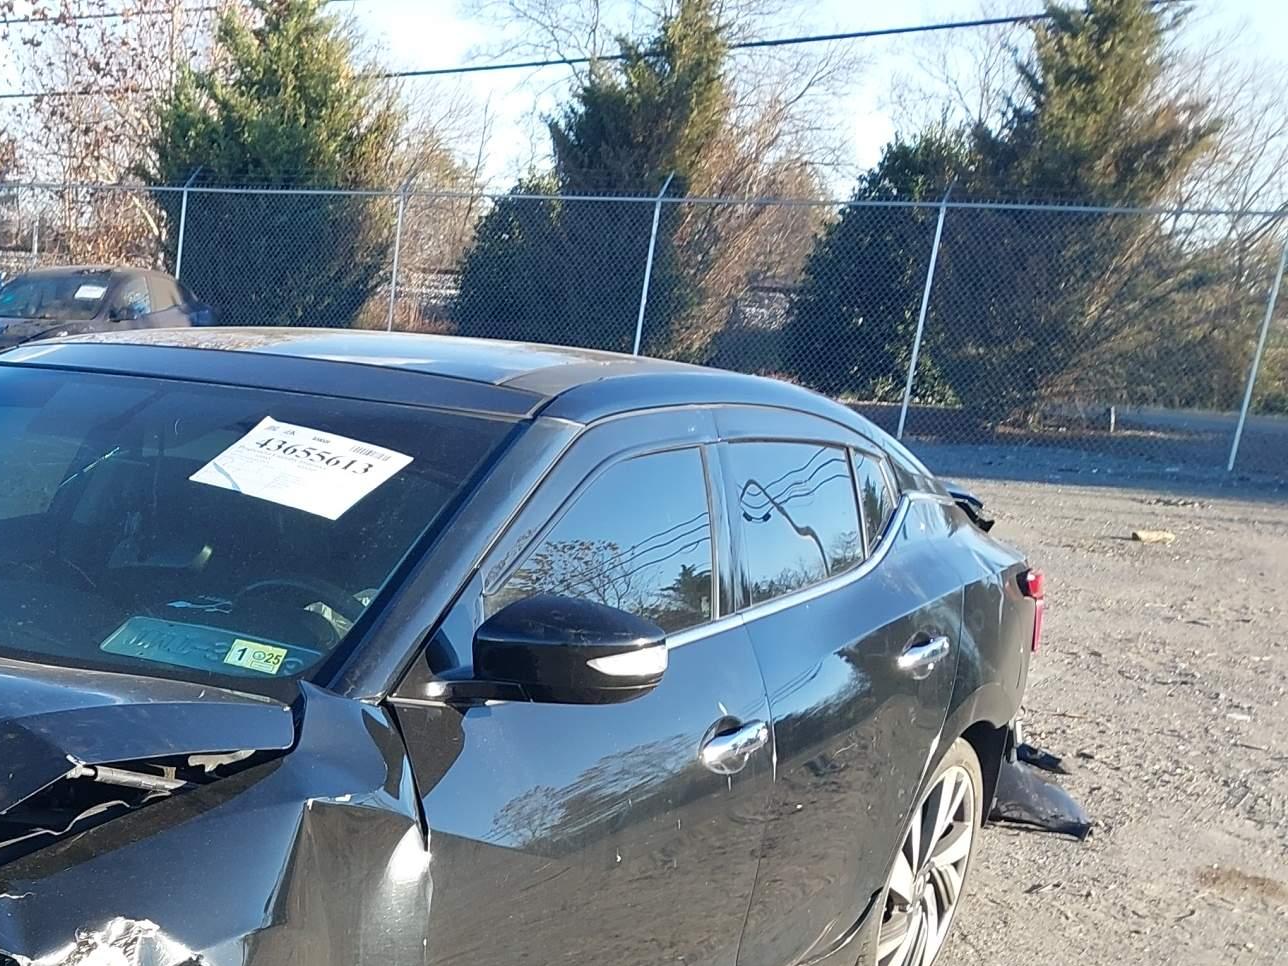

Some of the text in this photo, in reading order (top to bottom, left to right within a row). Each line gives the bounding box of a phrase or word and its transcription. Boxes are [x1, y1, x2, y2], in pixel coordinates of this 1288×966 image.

[255, 437, 374, 474] 43655613
[237, 647, 283, 666] 1 25
